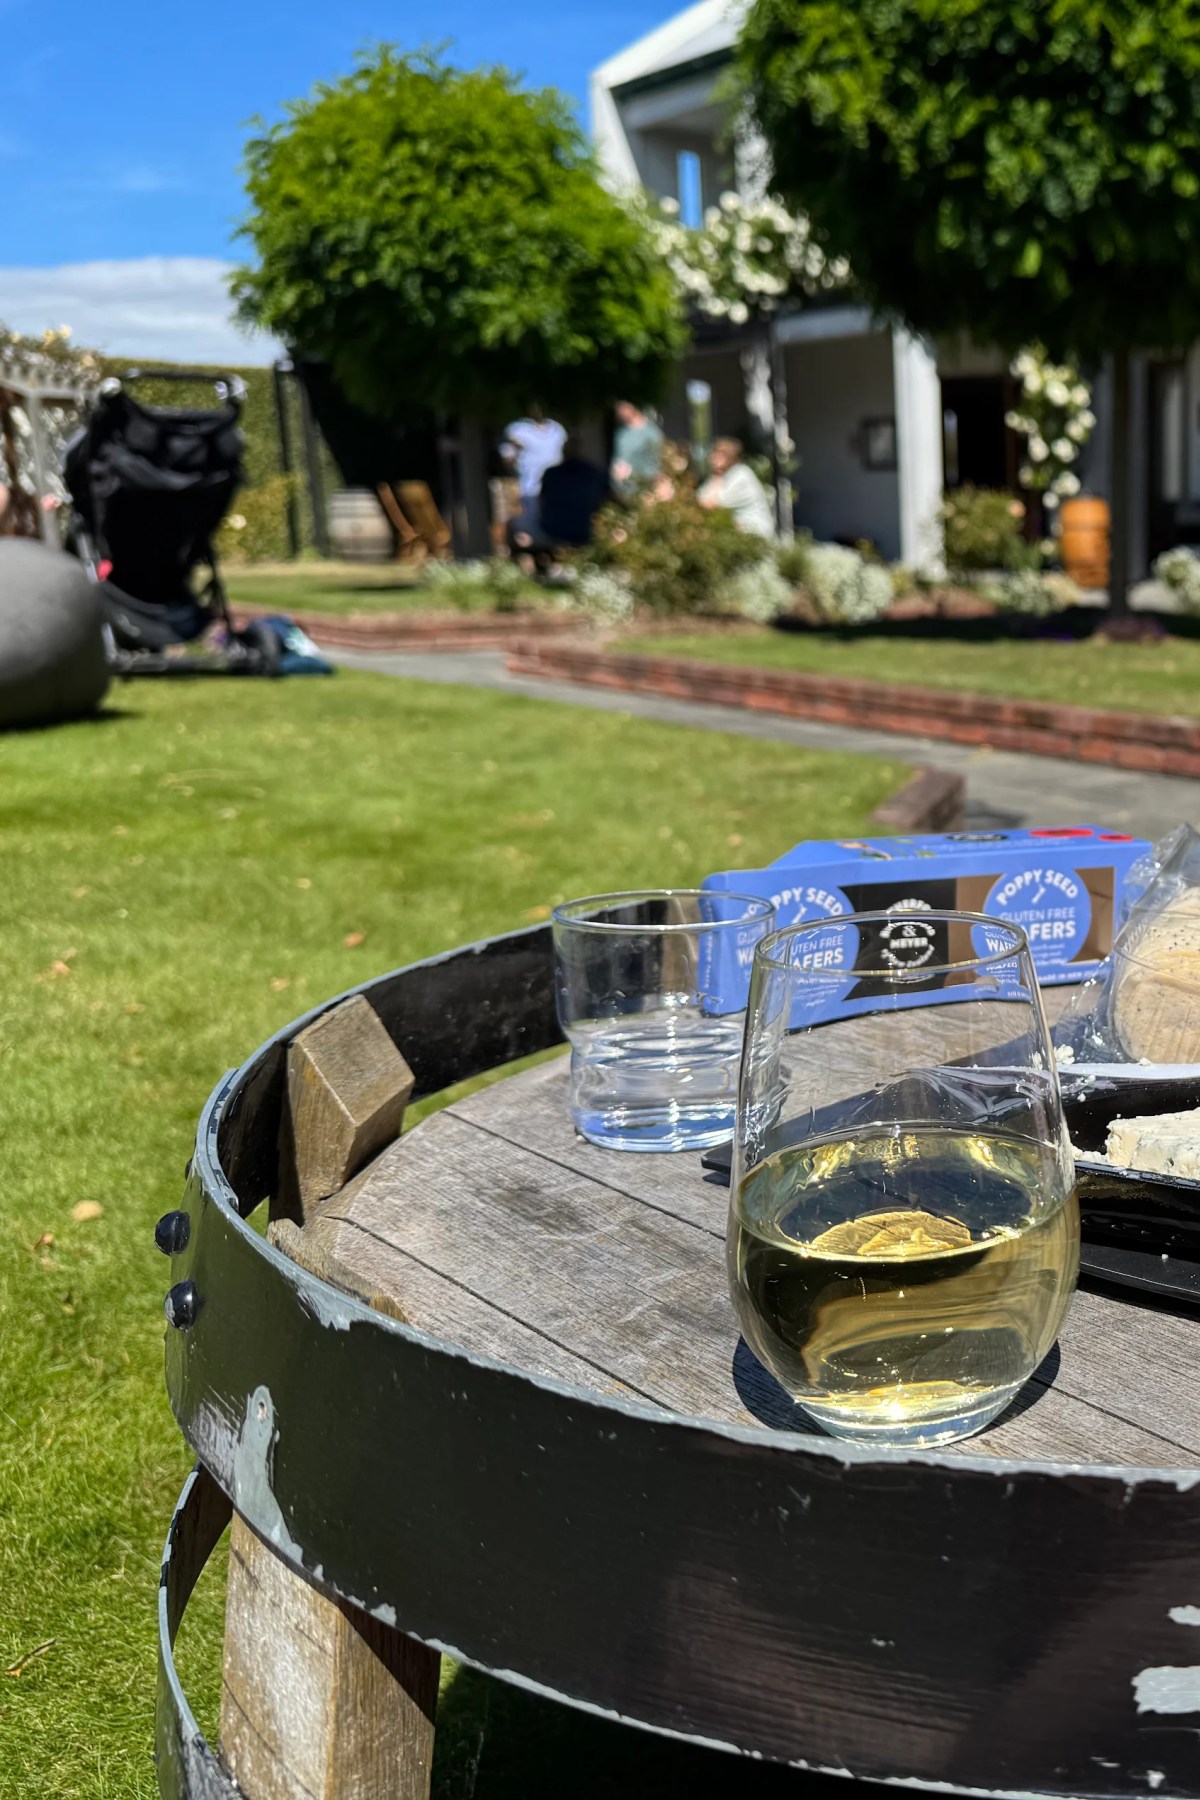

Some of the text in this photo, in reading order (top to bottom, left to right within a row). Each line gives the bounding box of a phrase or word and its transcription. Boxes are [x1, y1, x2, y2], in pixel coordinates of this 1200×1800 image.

[996, 868, 1078, 905] POPPY SEED
[806, 887, 843, 915] SEED
[1000, 907, 1075, 922] GLUTEN FREE
[820, 935, 843, 948] FREE
[890, 937, 928, 949] MEYER
